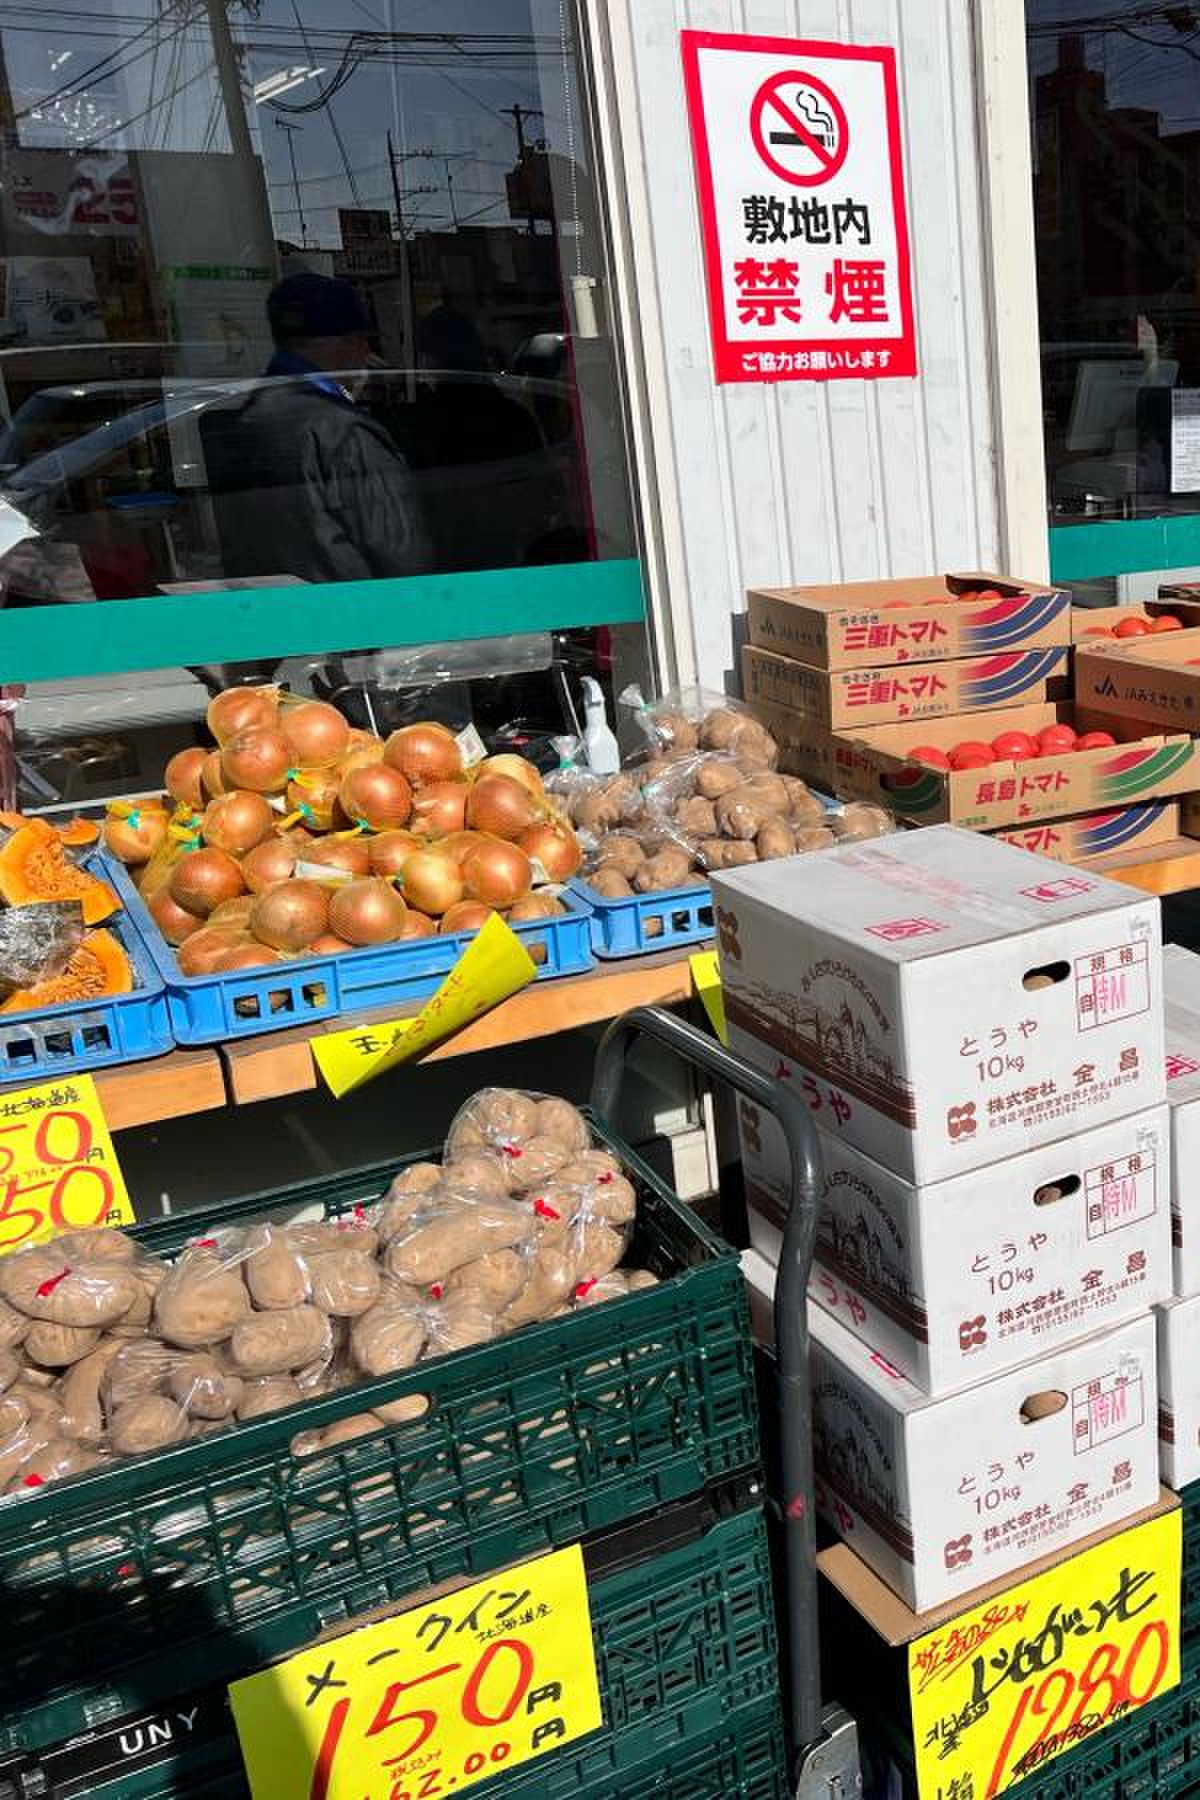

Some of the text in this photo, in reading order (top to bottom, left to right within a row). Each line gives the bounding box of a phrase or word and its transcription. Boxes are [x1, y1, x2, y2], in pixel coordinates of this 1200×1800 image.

[742, 195, 871, 244] 敷地内
[734, 257, 889, 326] 禁煙
[742, 350, 892, 374] ご協力お願いします
[844, 620, 948, 651] 三重トマト
[845, 675, 947, 707] 三重トマト
[958, 1020, 1038, 1058] とうや
[977, 1054, 1025, 1082] 10kg
[774, 1058, 853, 1127] とうや
[971, 1232, 1048, 1273] とうや
[818, 1274, 867, 1327] うや
[988, 1267, 1035, 1295] 10kg
[958, 1452, 1035, 1495] とうや
[973, 1485, 1022, 1514] 10kg
[306, 1589, 532, 1706] メークイン
[119, 1706, 199, 1755] UNY
[308, 1638, 562, 1800] 150 円
[985, 1620, 1169, 1800] 1280
[362, 1716, 566, 1800] 62.00 円
